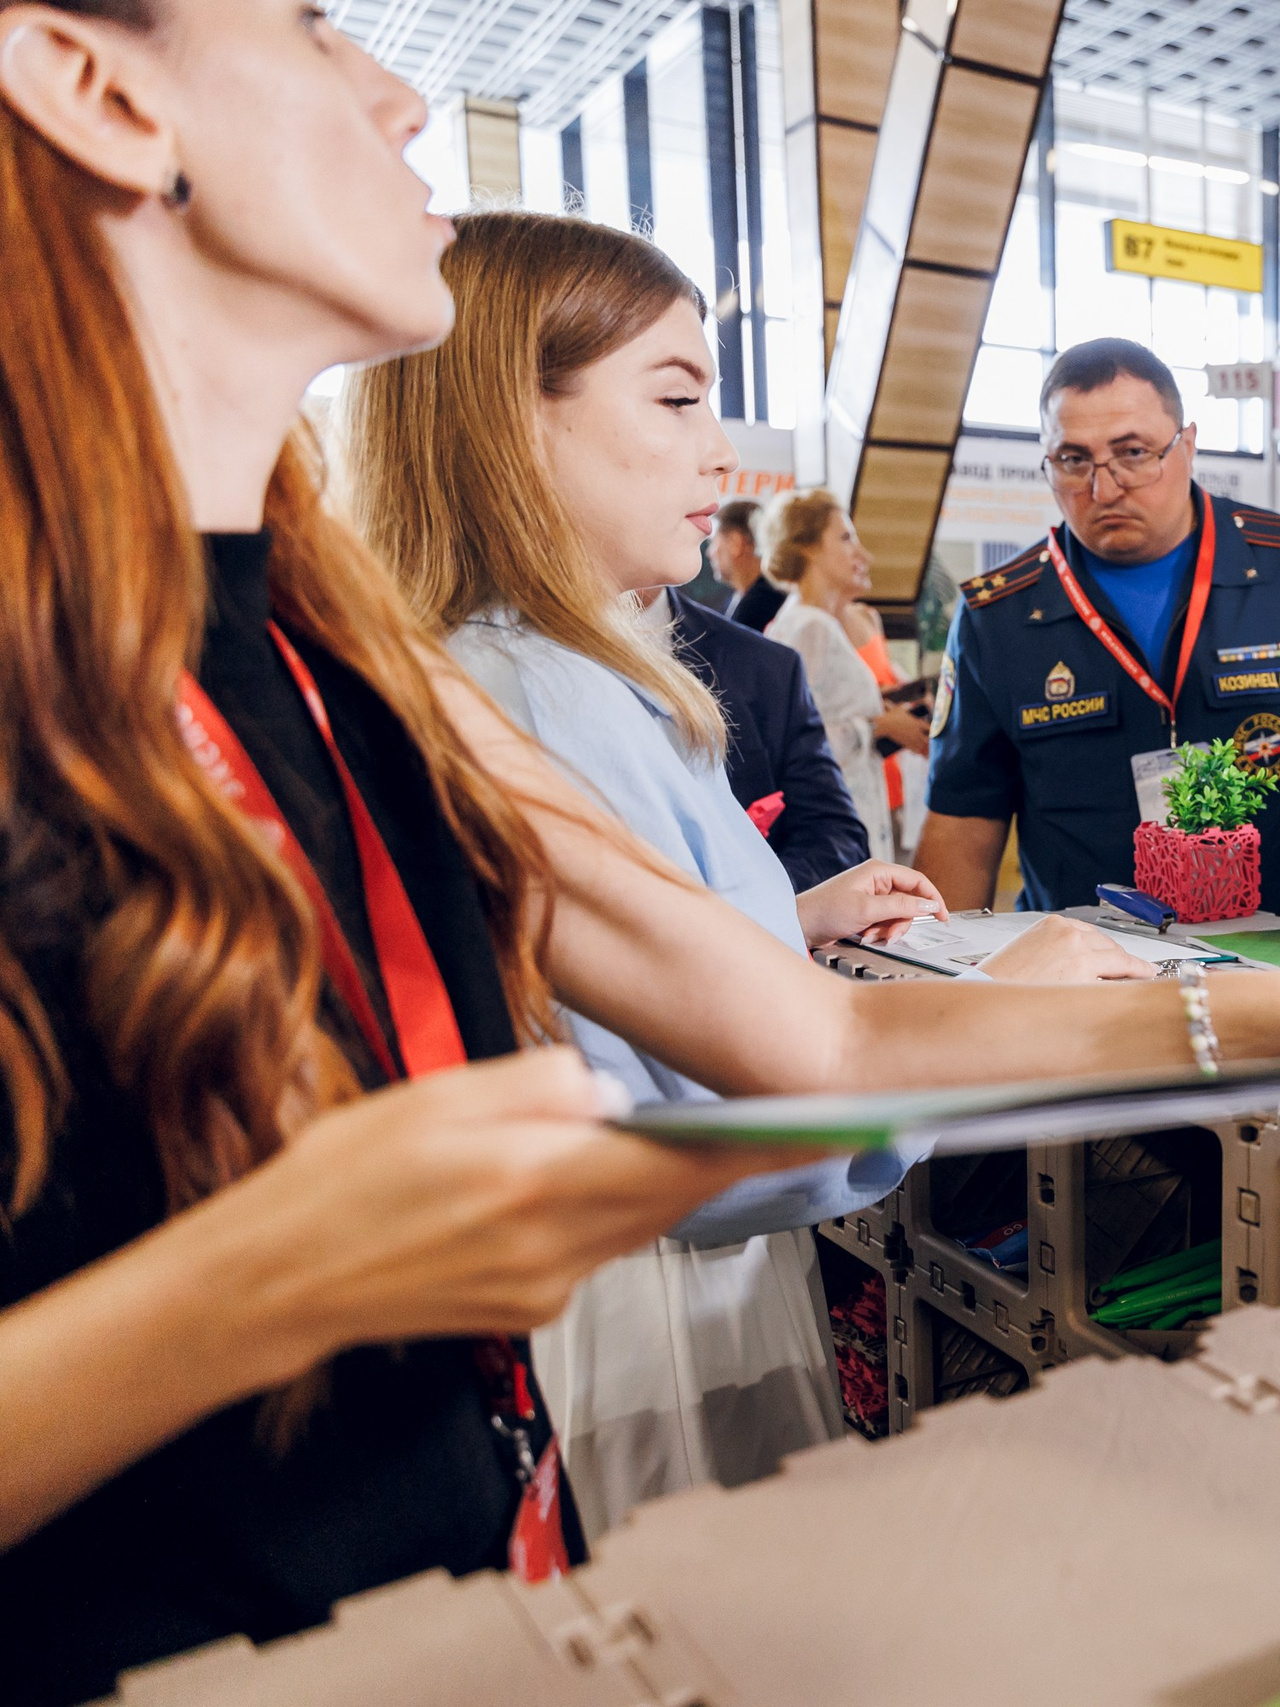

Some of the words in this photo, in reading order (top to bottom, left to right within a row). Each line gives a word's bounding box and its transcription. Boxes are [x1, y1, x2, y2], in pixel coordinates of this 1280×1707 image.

[1219, 370, 1258, 390] 115
[1218, 672, 1279, 692] КОЗИНЕЦ
[1022, 706, 1050, 725] МЧС
[1051, 696, 1105, 719] РОССИИ
